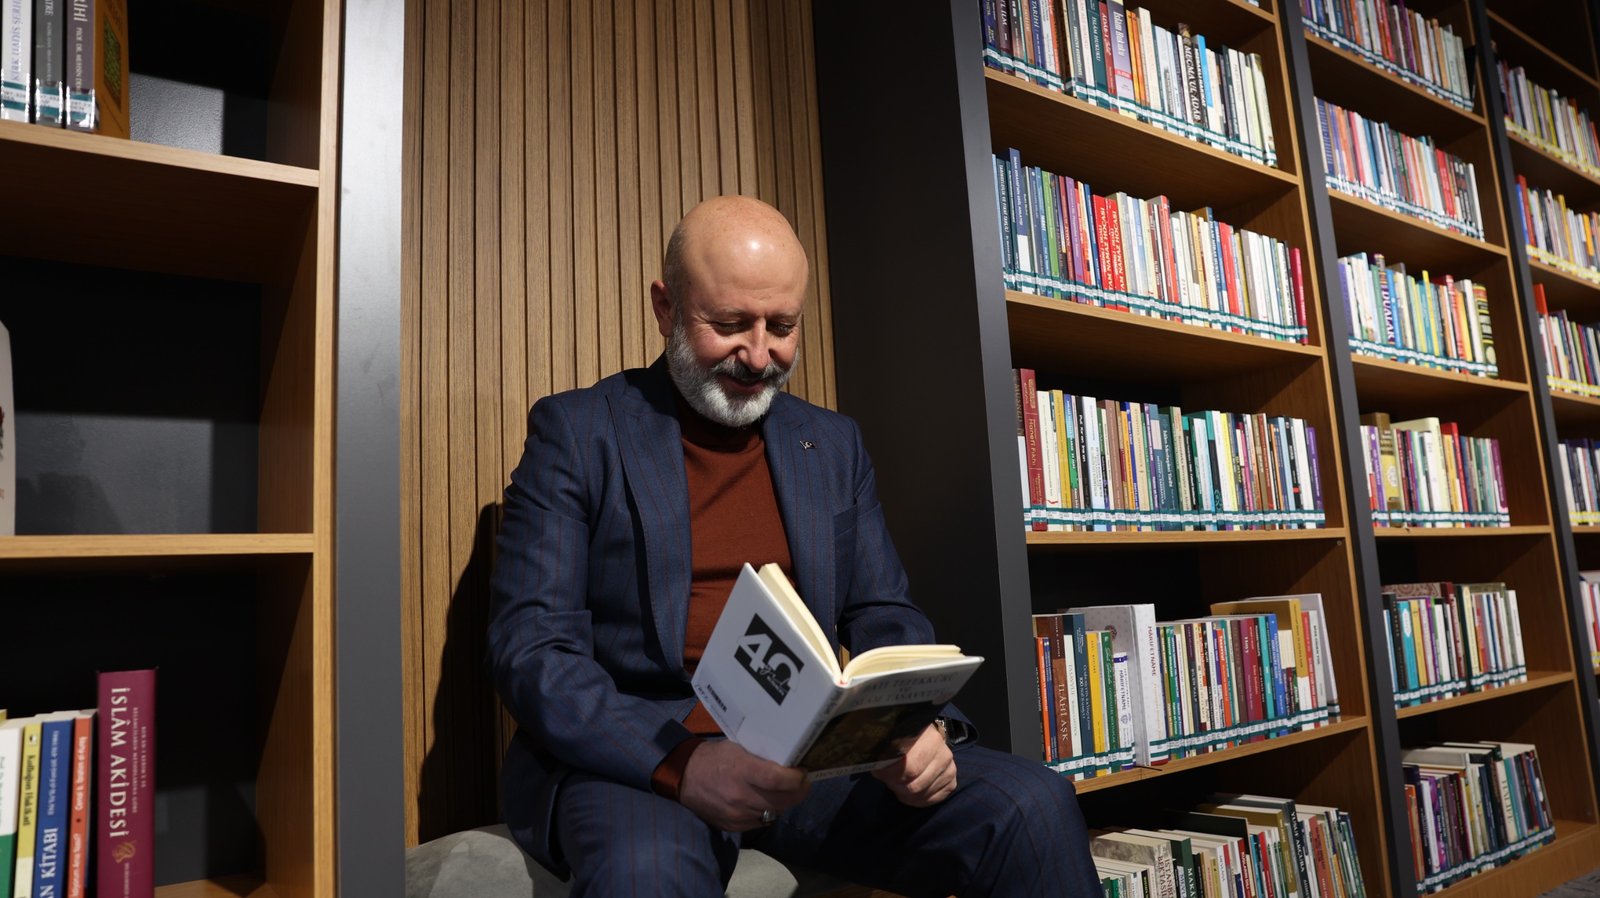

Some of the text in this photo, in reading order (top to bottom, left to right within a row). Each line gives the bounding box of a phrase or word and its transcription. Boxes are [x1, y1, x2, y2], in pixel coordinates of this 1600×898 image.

[1059, 719, 1068, 741] AŞK
[109, 687, 131, 837] İSLÂM AKİDESİ
[39, 827, 59, 878] KİTABI
